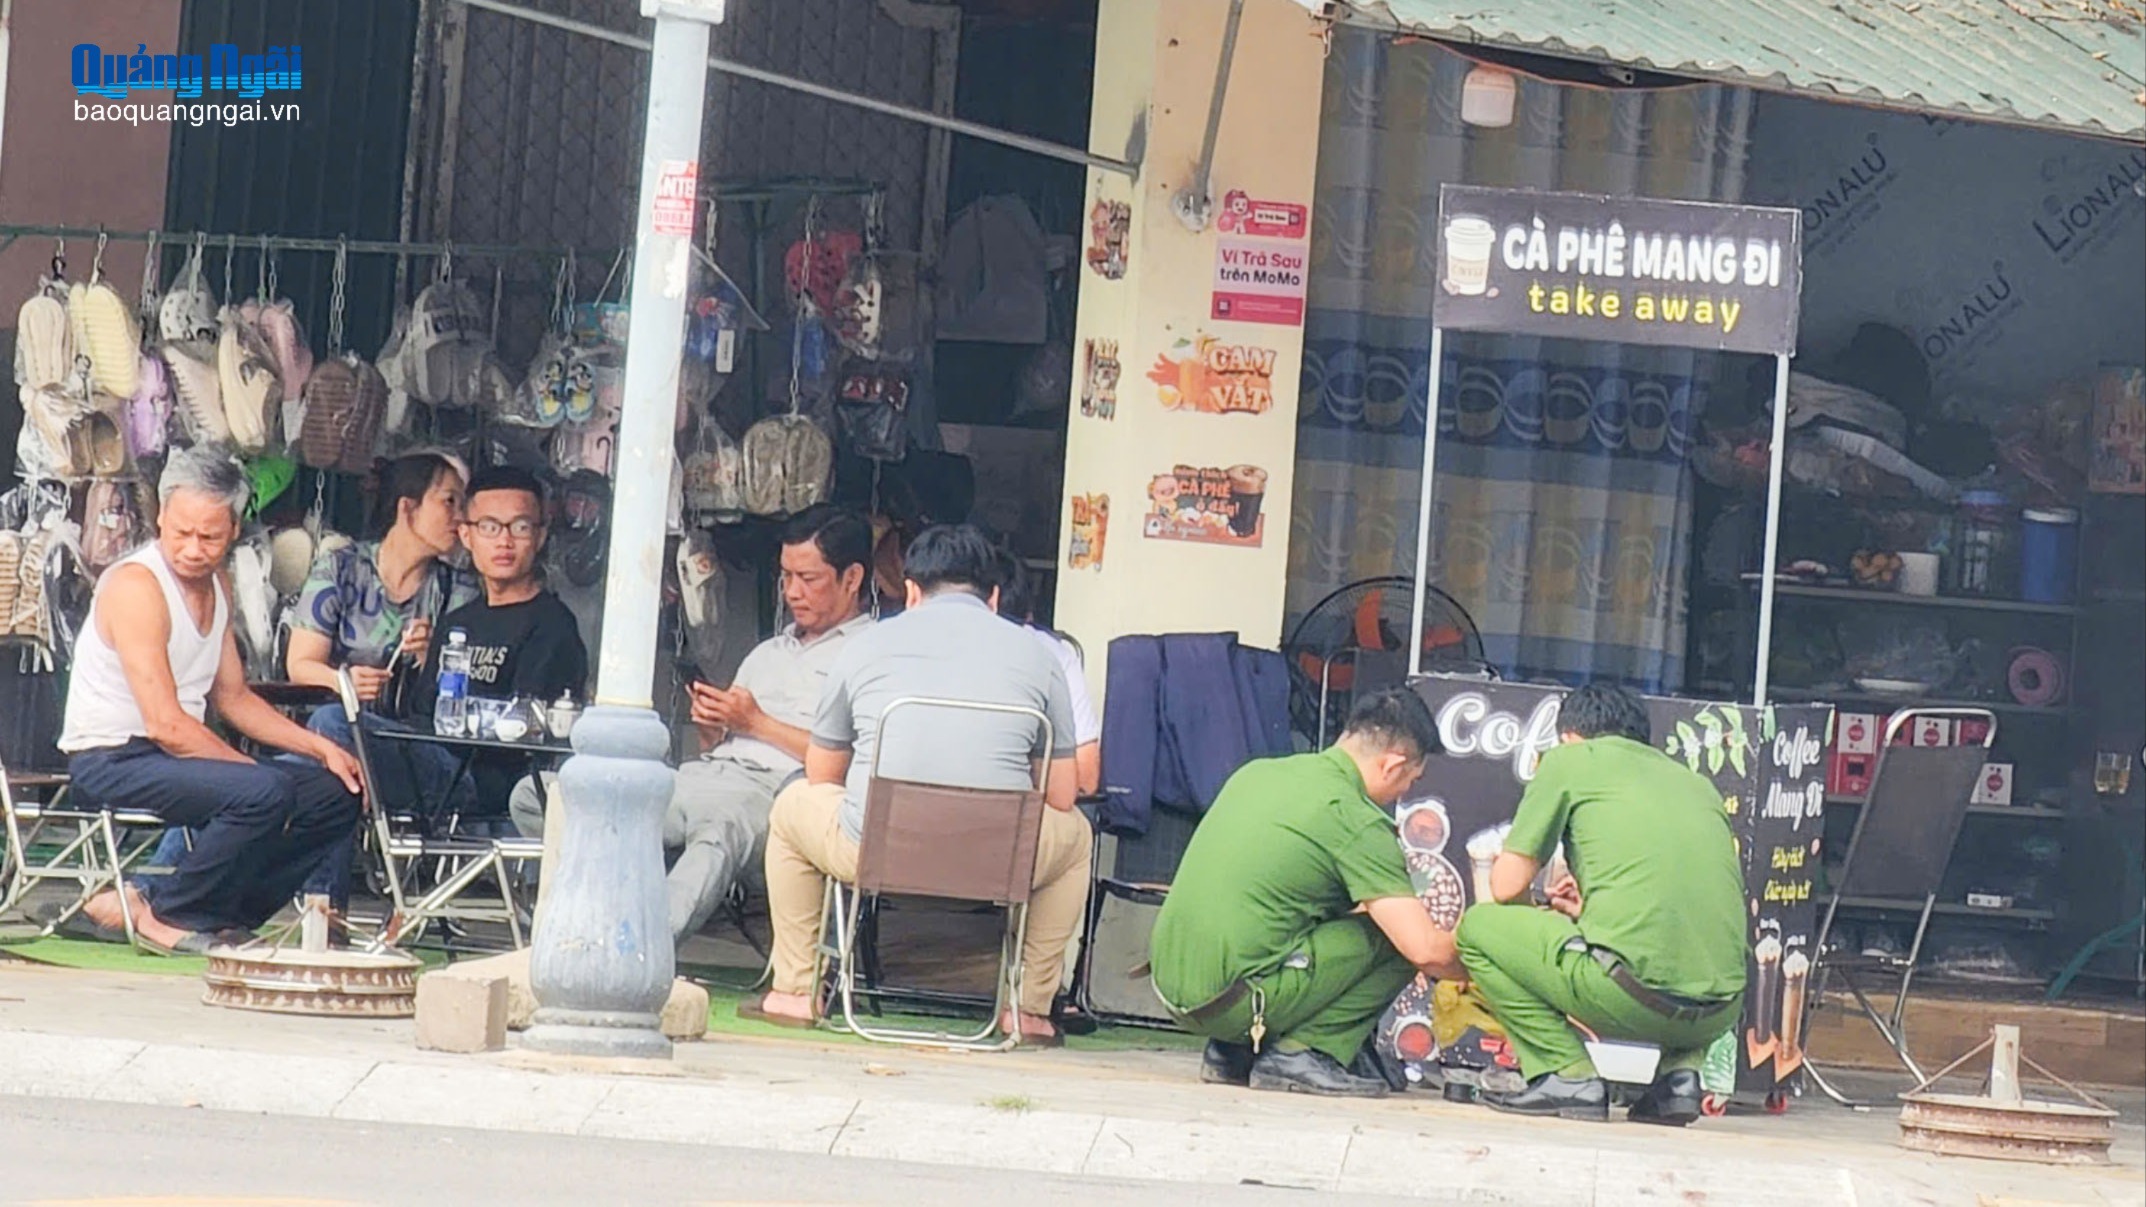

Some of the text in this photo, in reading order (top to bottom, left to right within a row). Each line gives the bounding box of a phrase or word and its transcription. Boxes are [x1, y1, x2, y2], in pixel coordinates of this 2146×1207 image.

[1802, 147, 1887, 233] ONALU
[1254, 269, 1300, 286] MoMo
[1271, 253, 1302, 269] Sau
[1503, 214, 1781, 287] CÀ PHÊ MANG ĐI
[1528, 280, 1742, 334] take away
[1923, 274, 2011, 361] ONALU
[1208, 345, 1277, 378] CAM
[1437, 695, 1561, 781] Cof
[1772, 726, 1821, 780] Coffee
[1761, 781, 1804, 832] Mang
